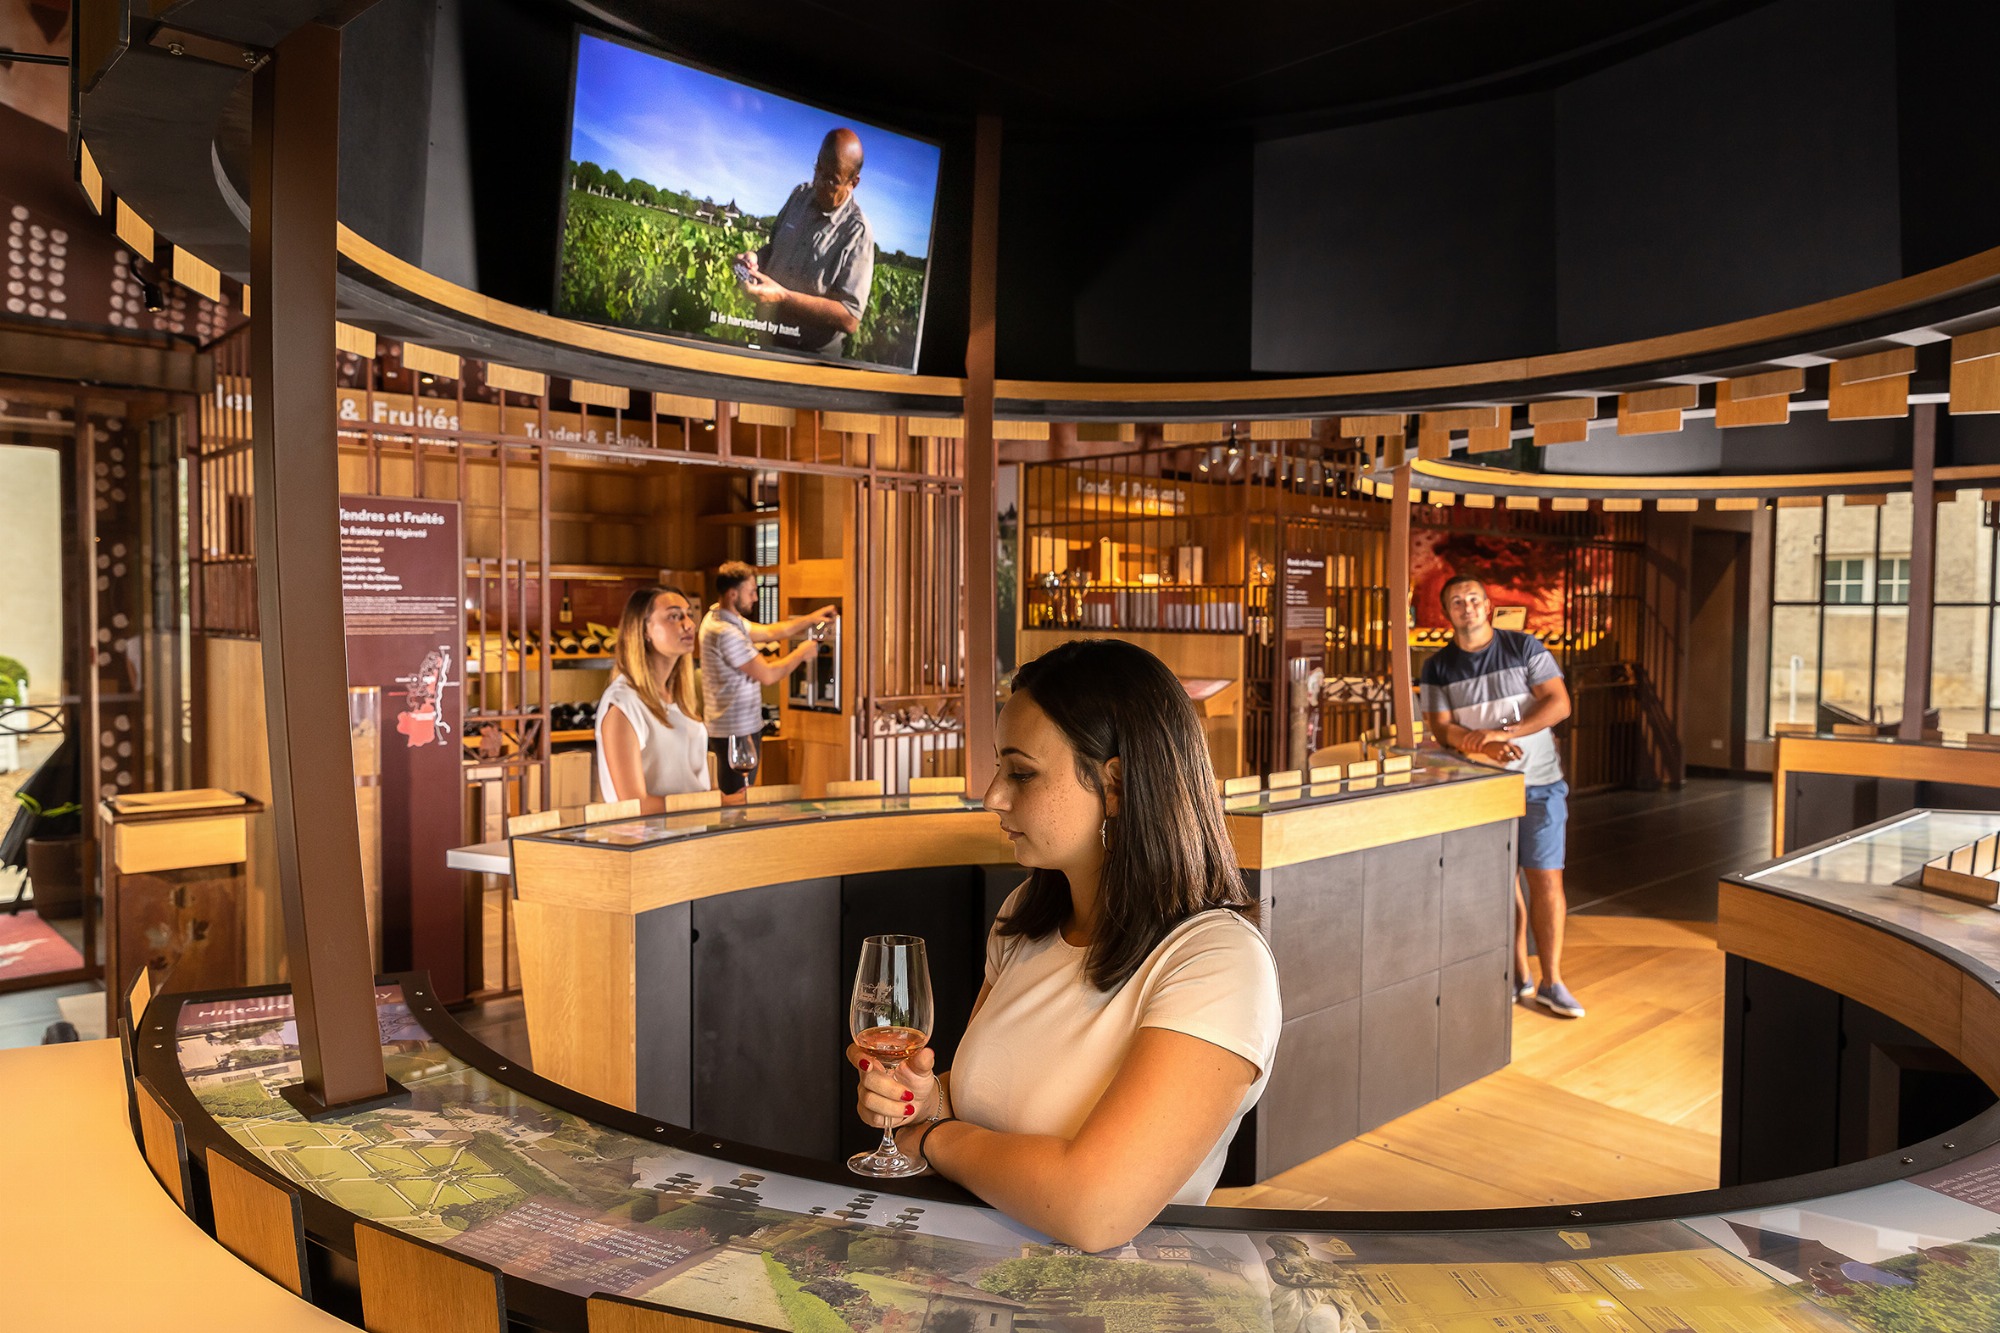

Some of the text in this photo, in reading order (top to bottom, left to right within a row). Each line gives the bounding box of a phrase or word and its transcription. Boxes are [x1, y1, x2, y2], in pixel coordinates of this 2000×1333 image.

[718, 312, 727, 325] is
[727, 315, 768, 332] harvested
[768, 320, 779, 335] by
[779, 322, 801, 337] hand.
[340, 398, 459, 432] & Fruités
[386, 511, 402, 523] et
[403, 511, 445, 525] Fruités
[198, 1003, 291, 1018] Histoire
[499, 1216, 528, 1226] Auvergne
[584, 1241, 609, 1250] domaine
[636, 1257, 669, 1269] complexe
[604, 1240, 637, 1252] Groupama
[610, 1235, 646, 1247] descendants
[635, 1235, 661, 1245] seigneur
